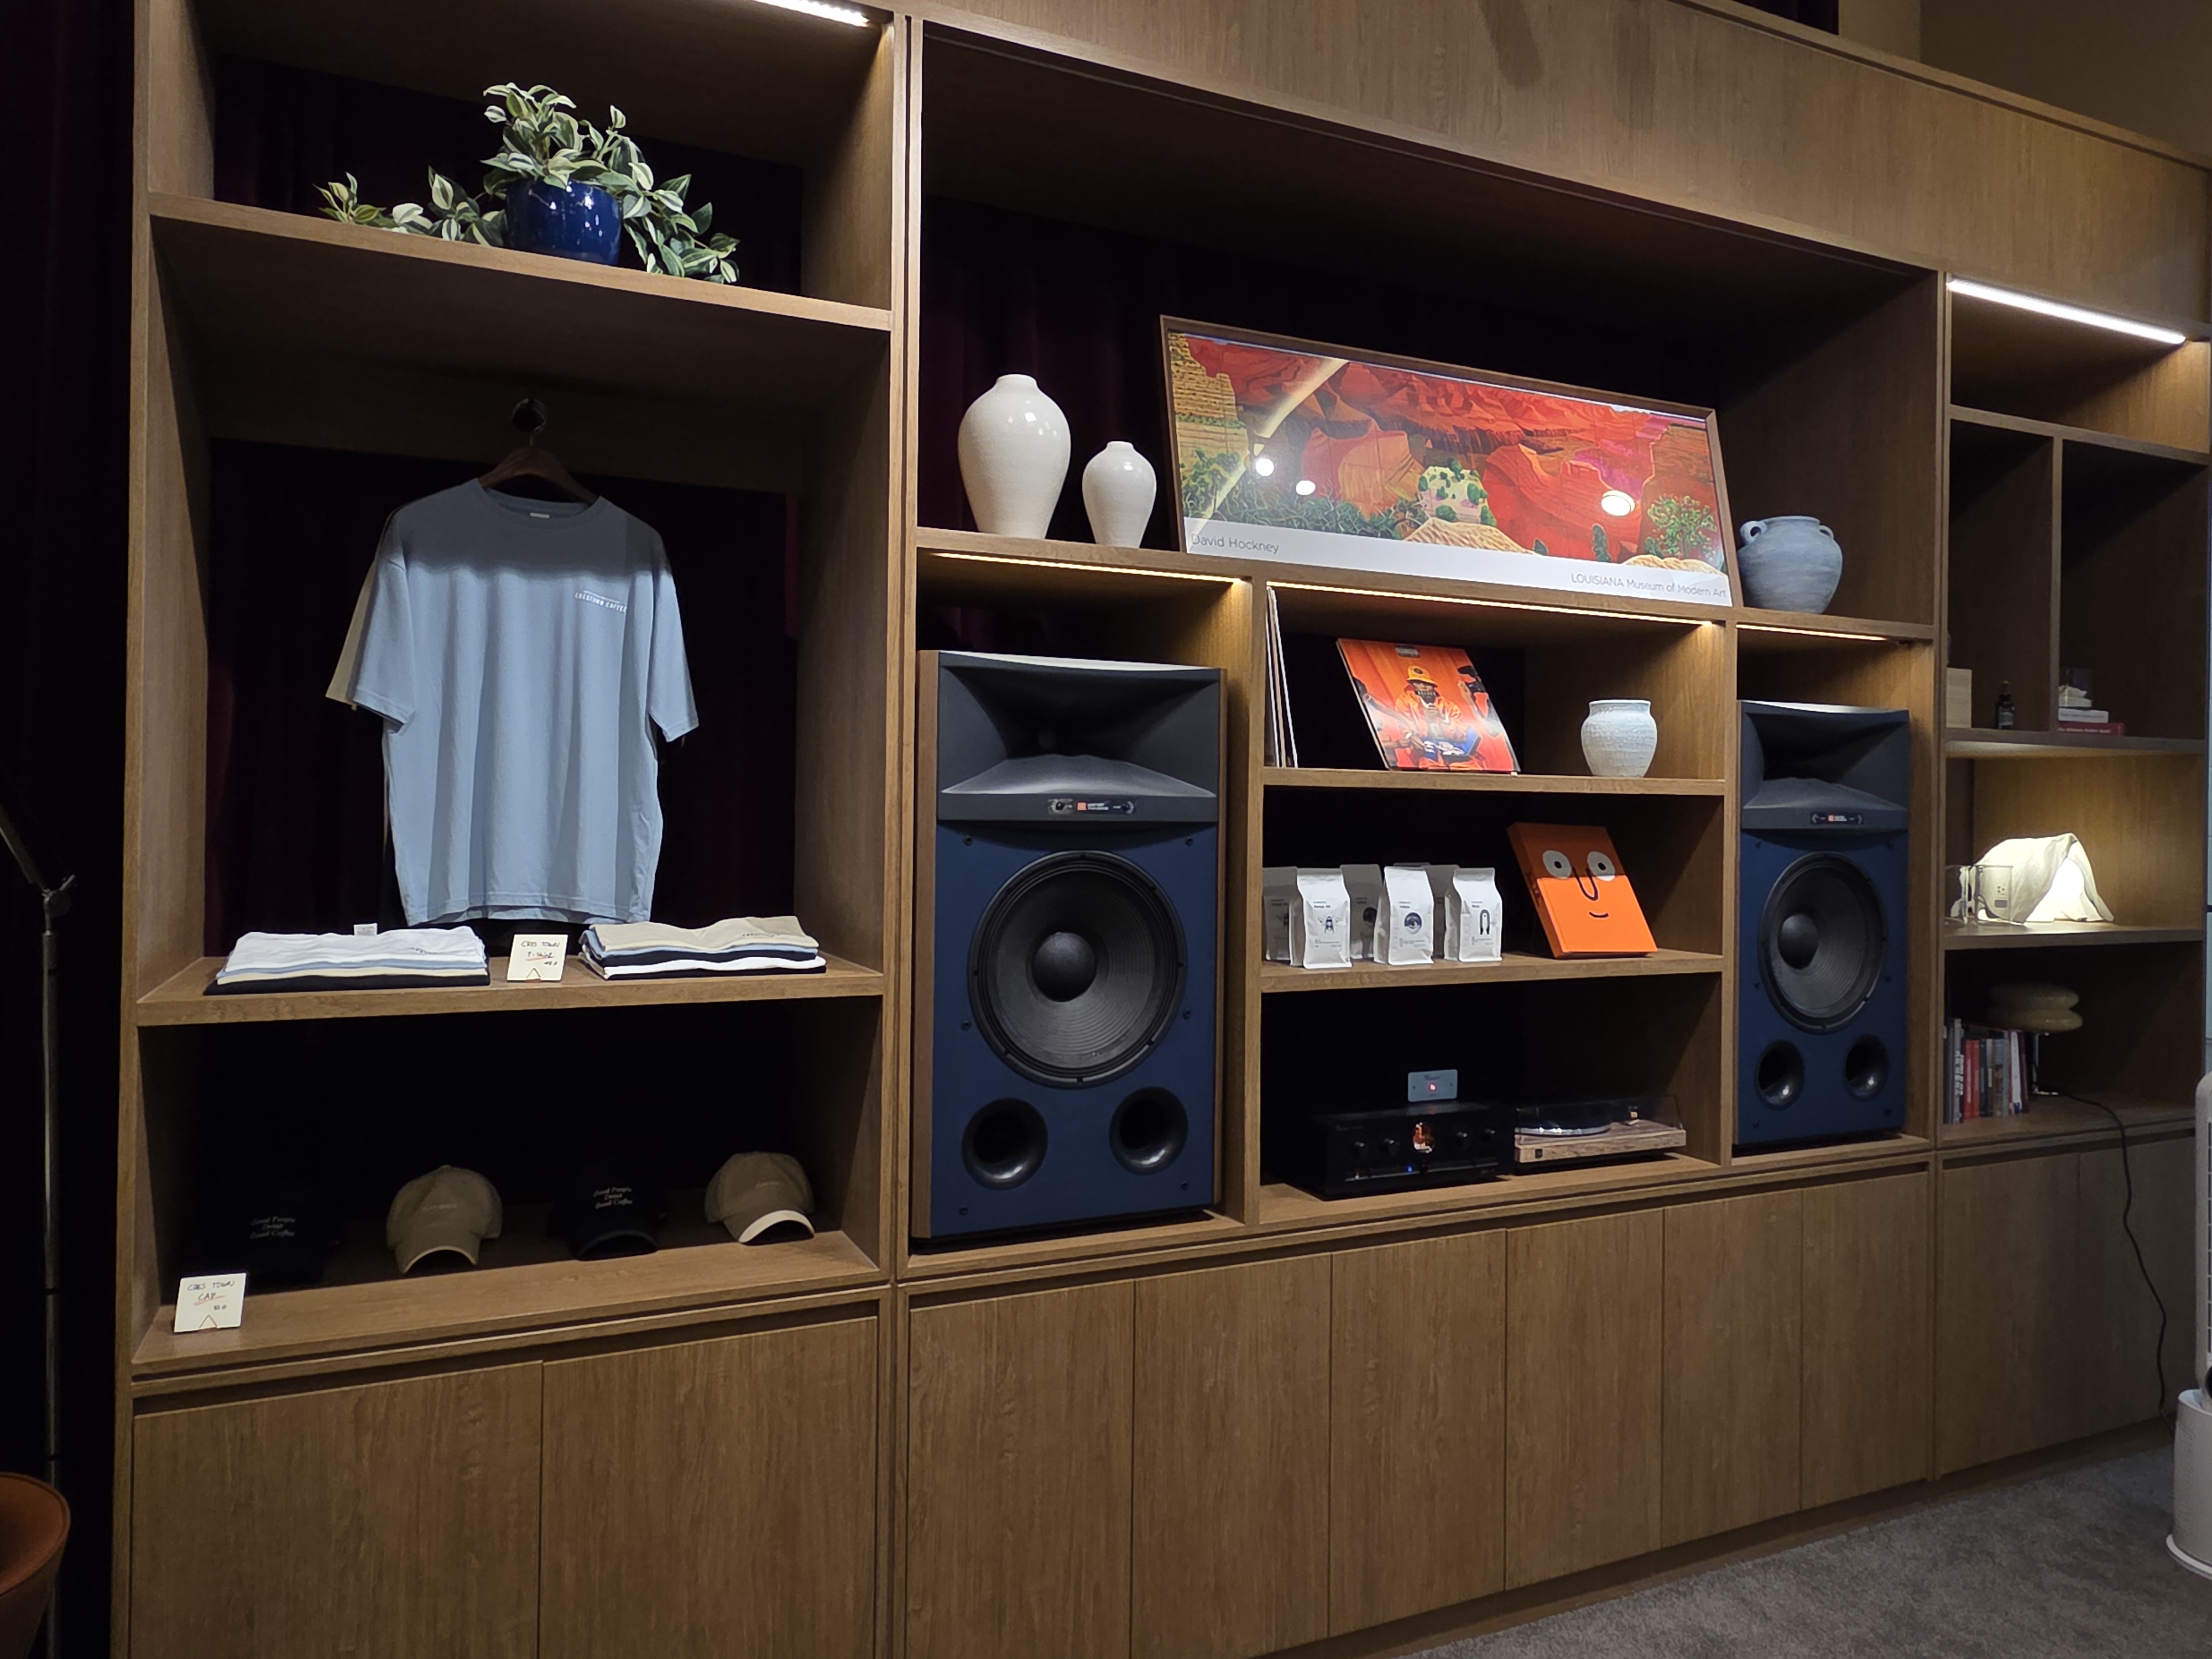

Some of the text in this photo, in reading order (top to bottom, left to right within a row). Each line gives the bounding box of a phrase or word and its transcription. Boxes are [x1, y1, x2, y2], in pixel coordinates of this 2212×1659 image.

[1191, 533, 1279, 555] David Hockney
[1571, 572, 1726, 598] LOUISIANA Museum of Modern Art
[197, 1292, 216, 1301] CAP
